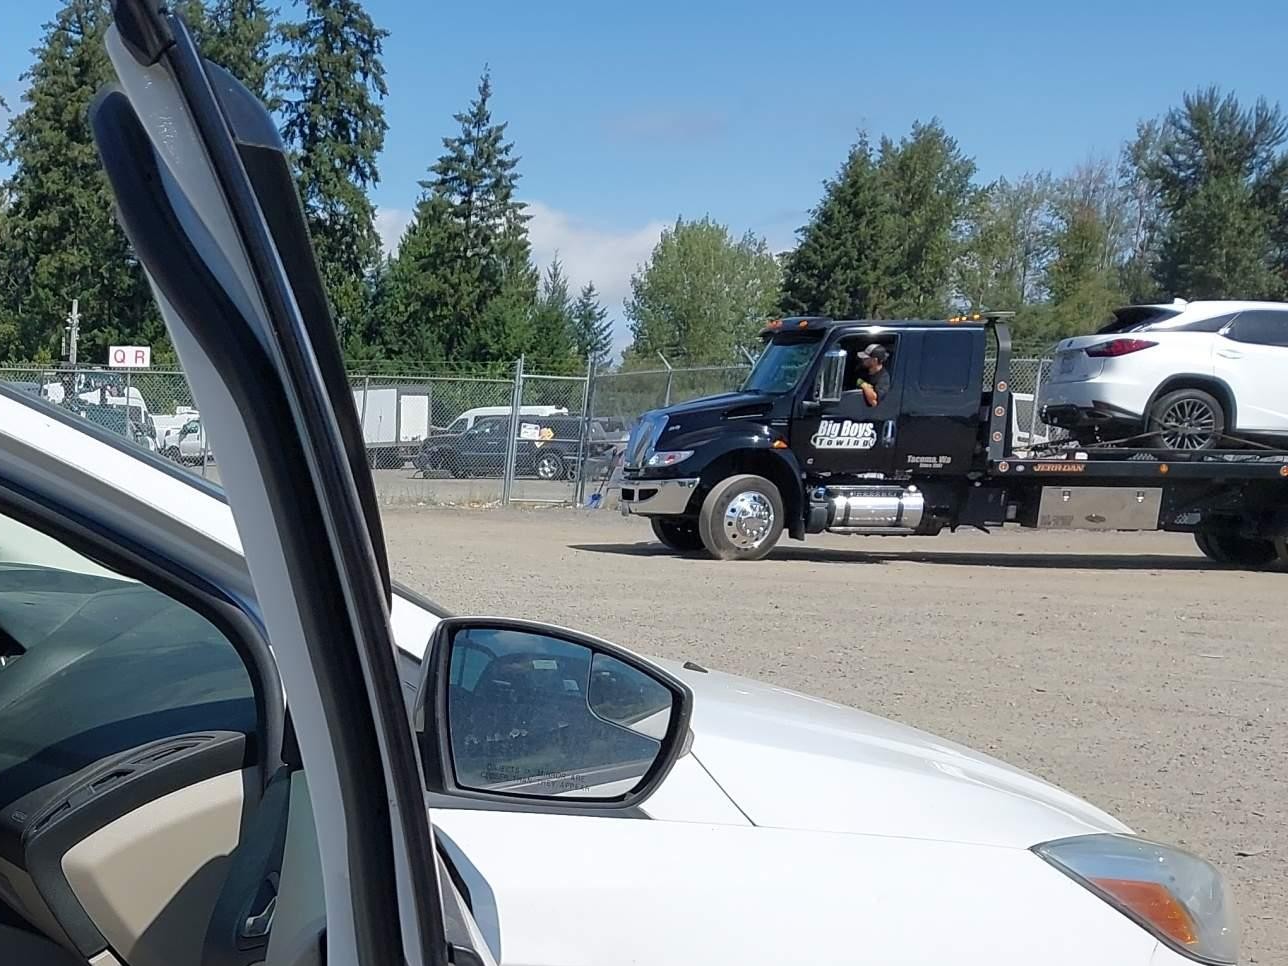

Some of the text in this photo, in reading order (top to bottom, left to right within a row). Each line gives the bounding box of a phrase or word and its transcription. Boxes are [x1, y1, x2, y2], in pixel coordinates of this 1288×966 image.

[114, 349, 145, 364] Q R
[818, 420, 873, 437] Big Boys
[818, 438, 870, 447] Towing
